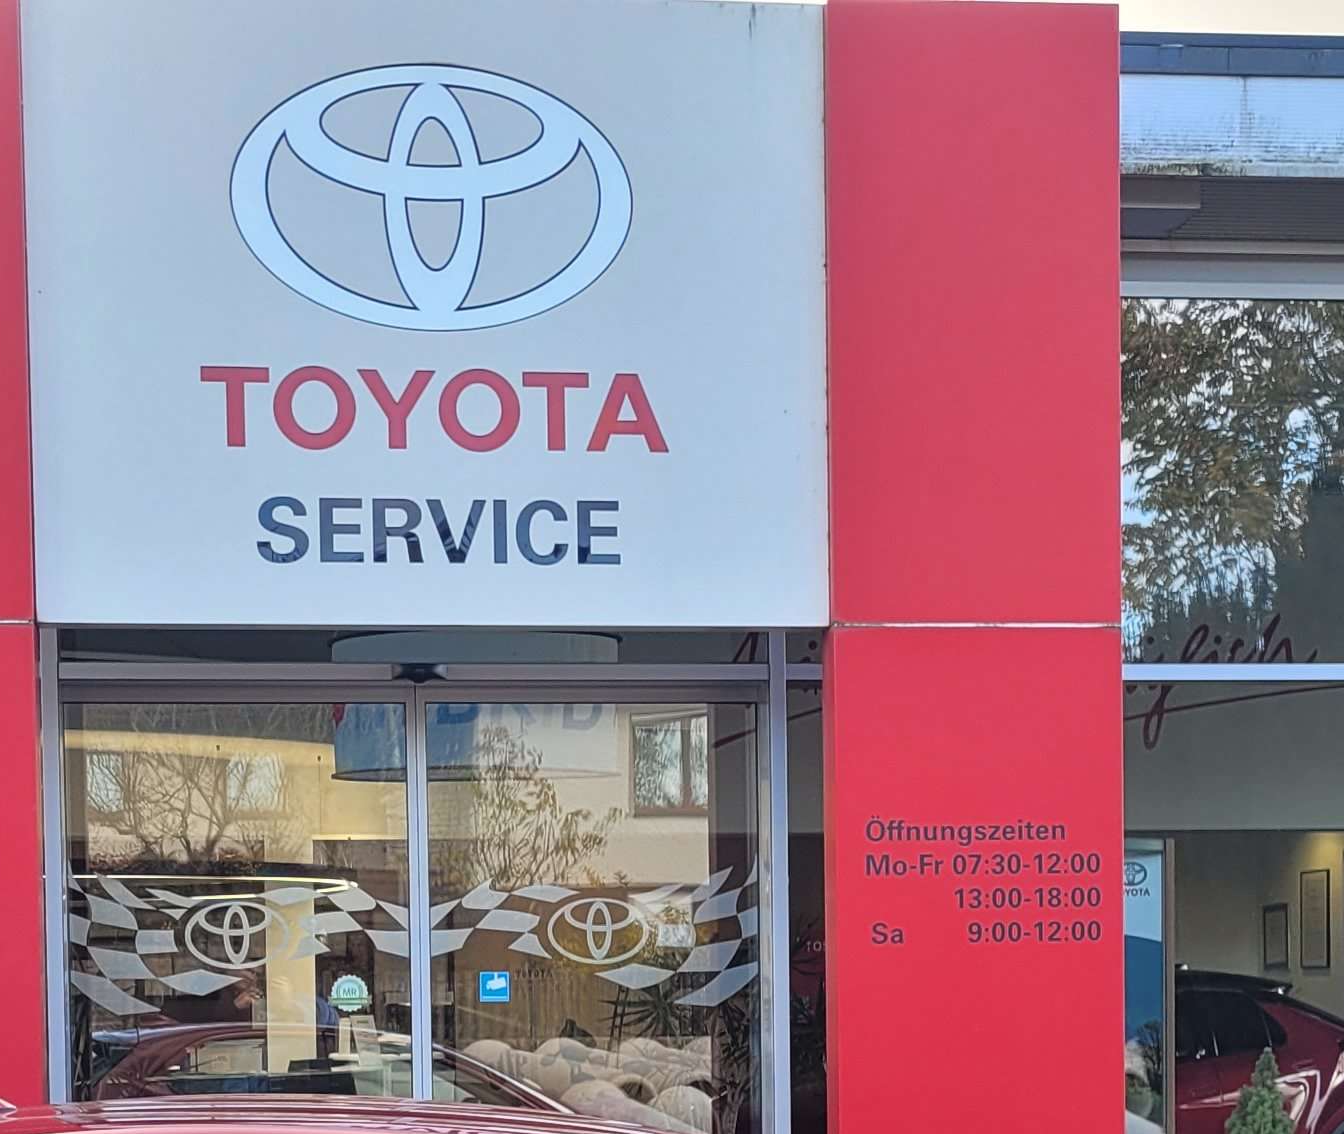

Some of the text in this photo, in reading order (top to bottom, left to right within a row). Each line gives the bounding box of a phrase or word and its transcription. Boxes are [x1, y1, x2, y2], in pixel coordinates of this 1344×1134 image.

[200, 365, 670, 454] TOYOTA
[256, 496, 622, 566] SERVICE
[865, 815, 1067, 847] Öffnungszeiten
[864, 852, 1102, 876] Mo-Fr 07:30-12:00
[954, 886, 1102, 909] 13:00-18:00
[871, 921, 1102, 945] Sa 9:00-12:00
